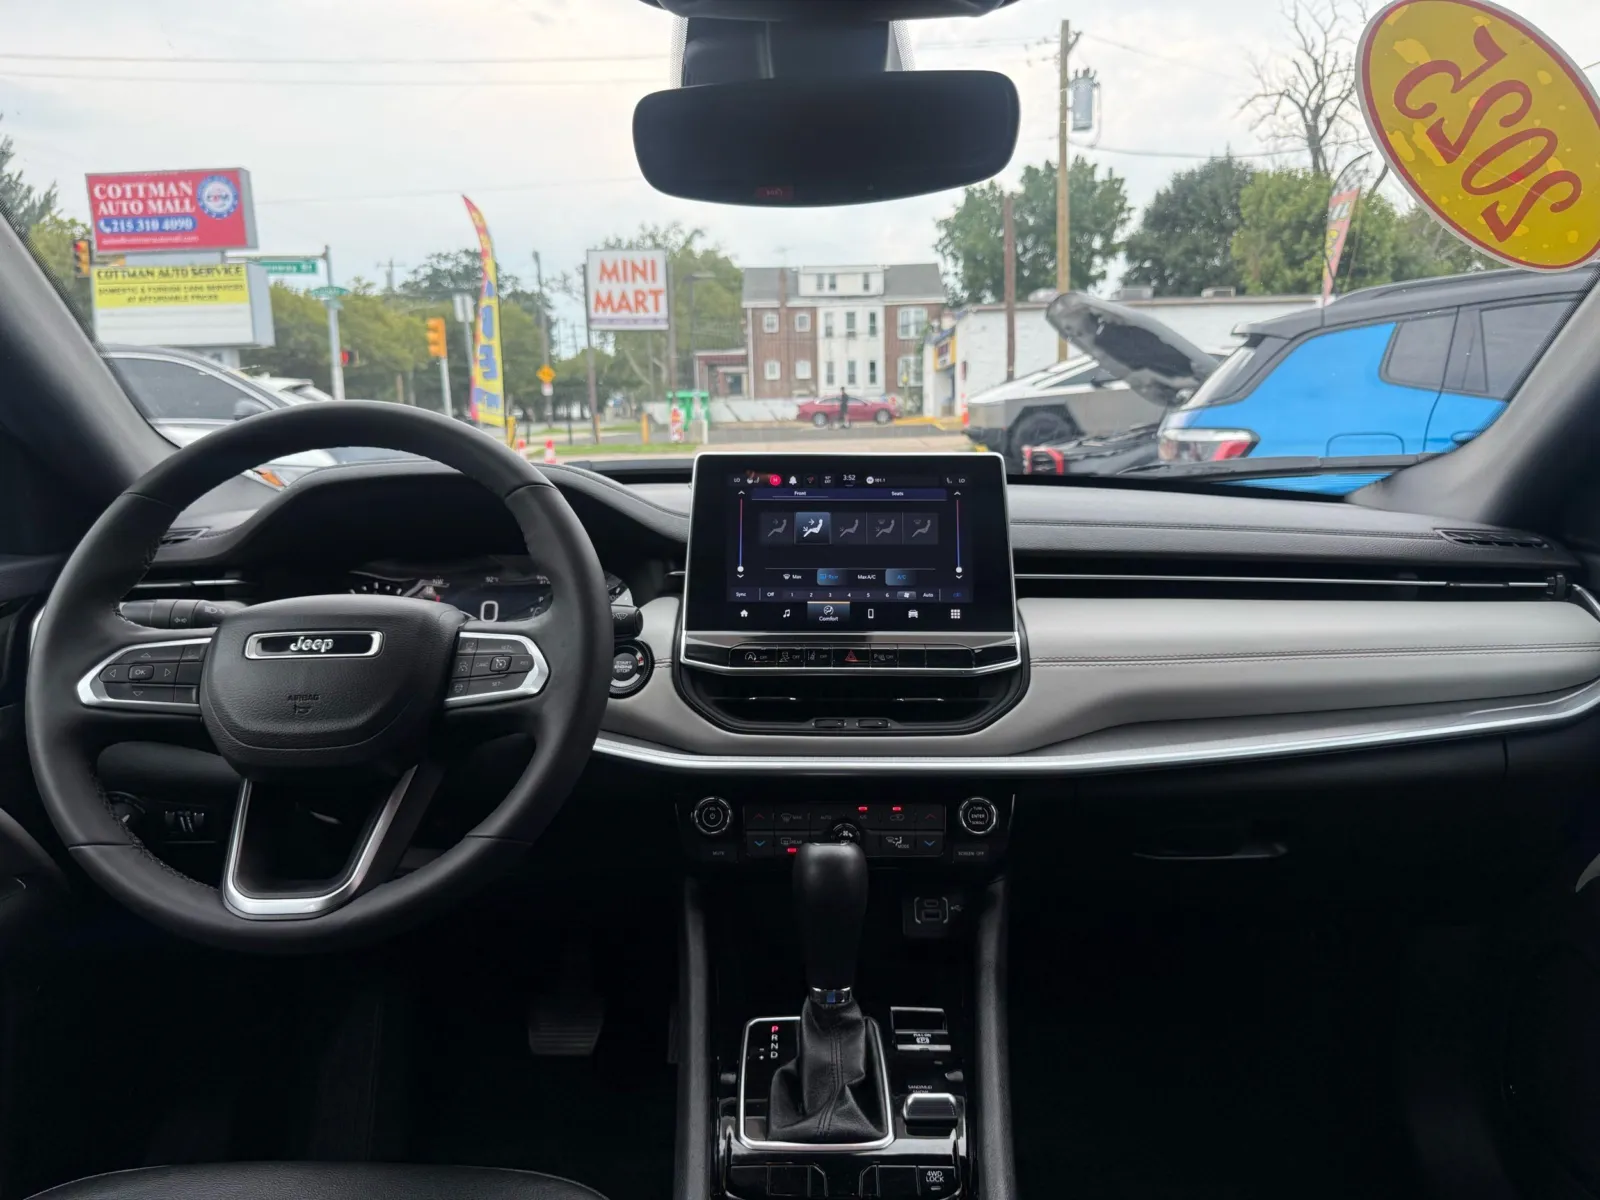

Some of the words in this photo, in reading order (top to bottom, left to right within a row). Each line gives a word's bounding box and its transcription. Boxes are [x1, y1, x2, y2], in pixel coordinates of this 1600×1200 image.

[94, 180, 193, 200] COTTMAN
[98, 199, 144, 216] AUTO
[147, 198, 195, 215] MALL
[111, 218, 135, 232] 215
[136, 218, 160, 232] 310
[97, 268, 155, 280] COTTMAN
[159, 267, 189, 278] AUTO
[191, 266, 243, 277] SERVICE
[599, 258, 657, 284] MINI
[594, 289, 665, 314] MART
[480, 600, 499, 623] 0
[289, 635, 335, 653] Jeep
[770, 1025, 779, 1033] P
[770, 1034, 779, 1042] R
[770, 1042, 779, 1050] N
[770, 1051, 779, 1059] D
